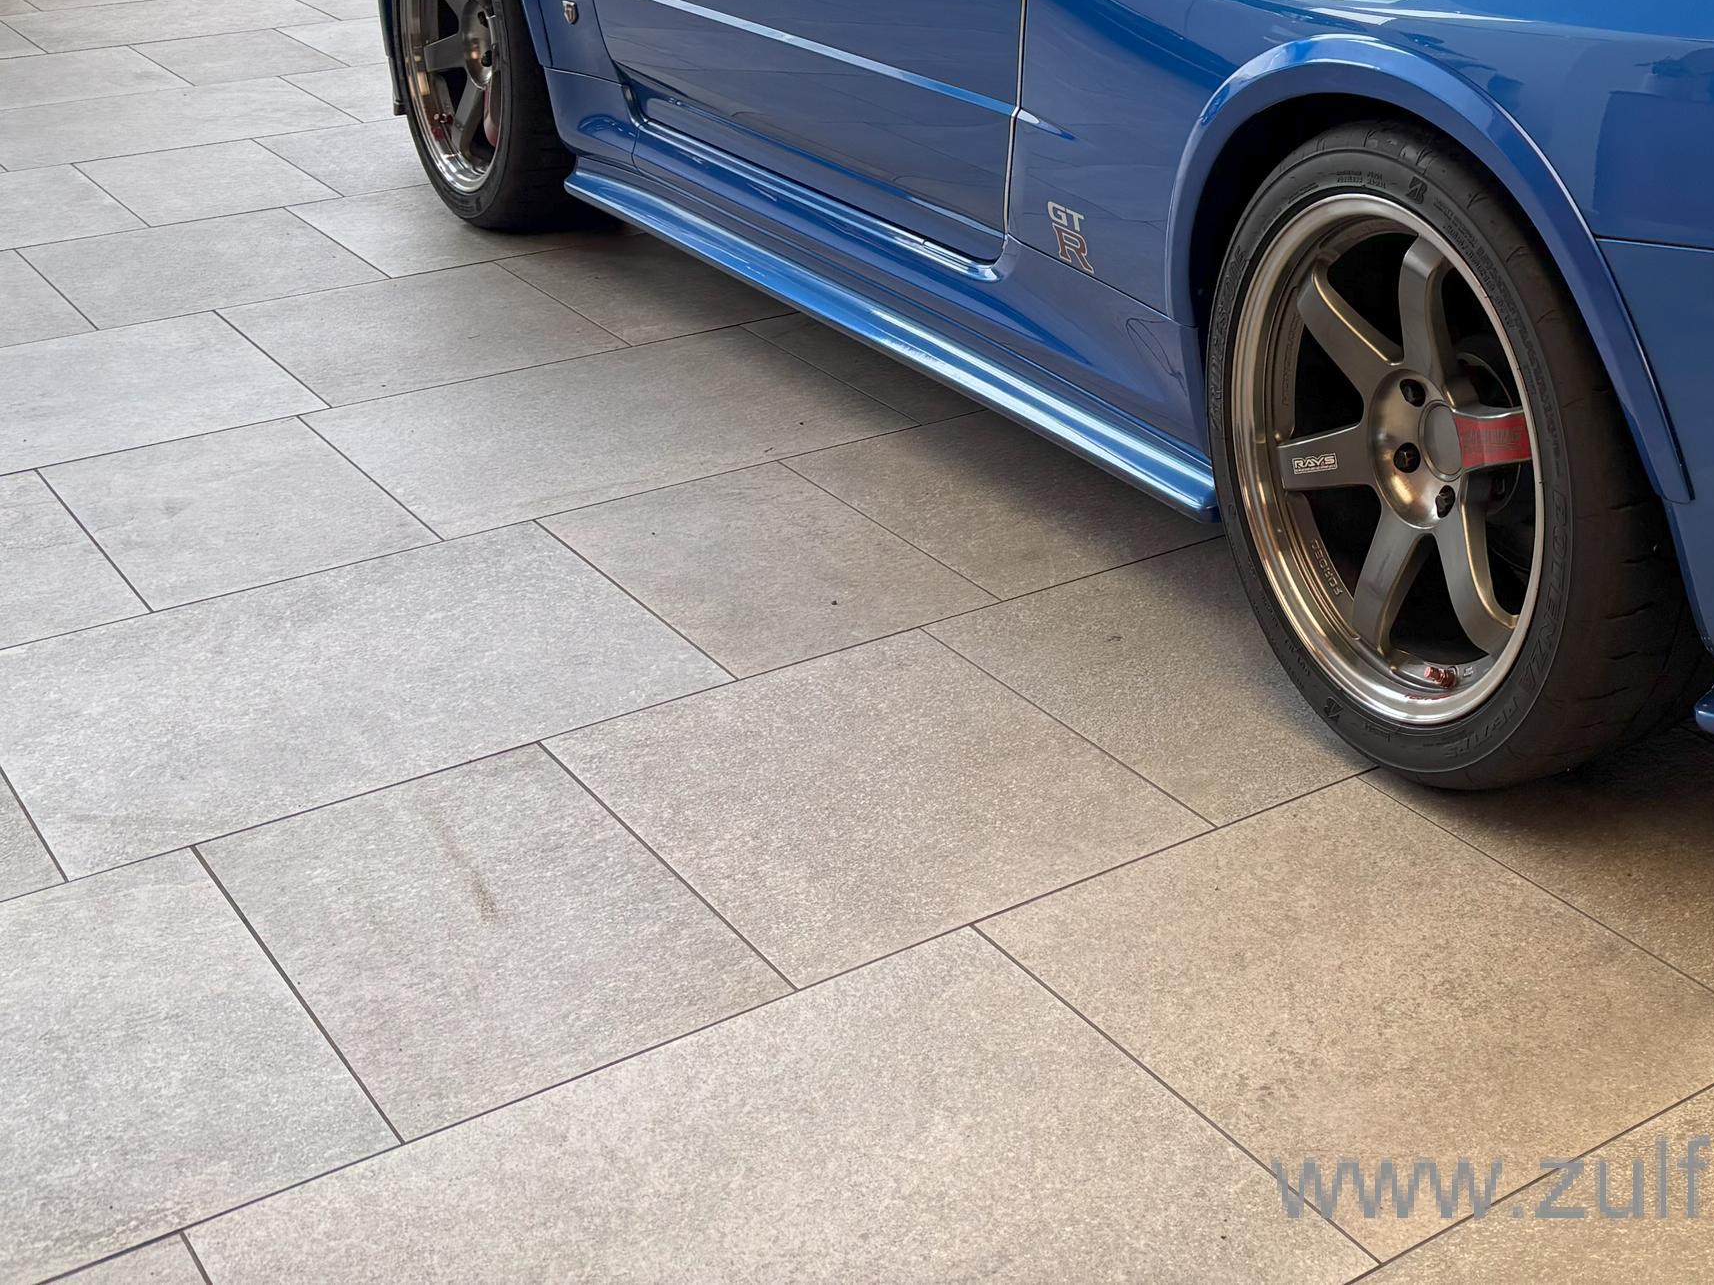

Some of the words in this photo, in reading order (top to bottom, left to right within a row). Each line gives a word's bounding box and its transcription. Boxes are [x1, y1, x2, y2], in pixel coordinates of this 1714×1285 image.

[1047, 201, 1085, 232] GT
[1052, 222, 1095, 274] R
[1294, 455, 1335, 469] RAYS
[1517, 488, 1569, 693] POTENZA
